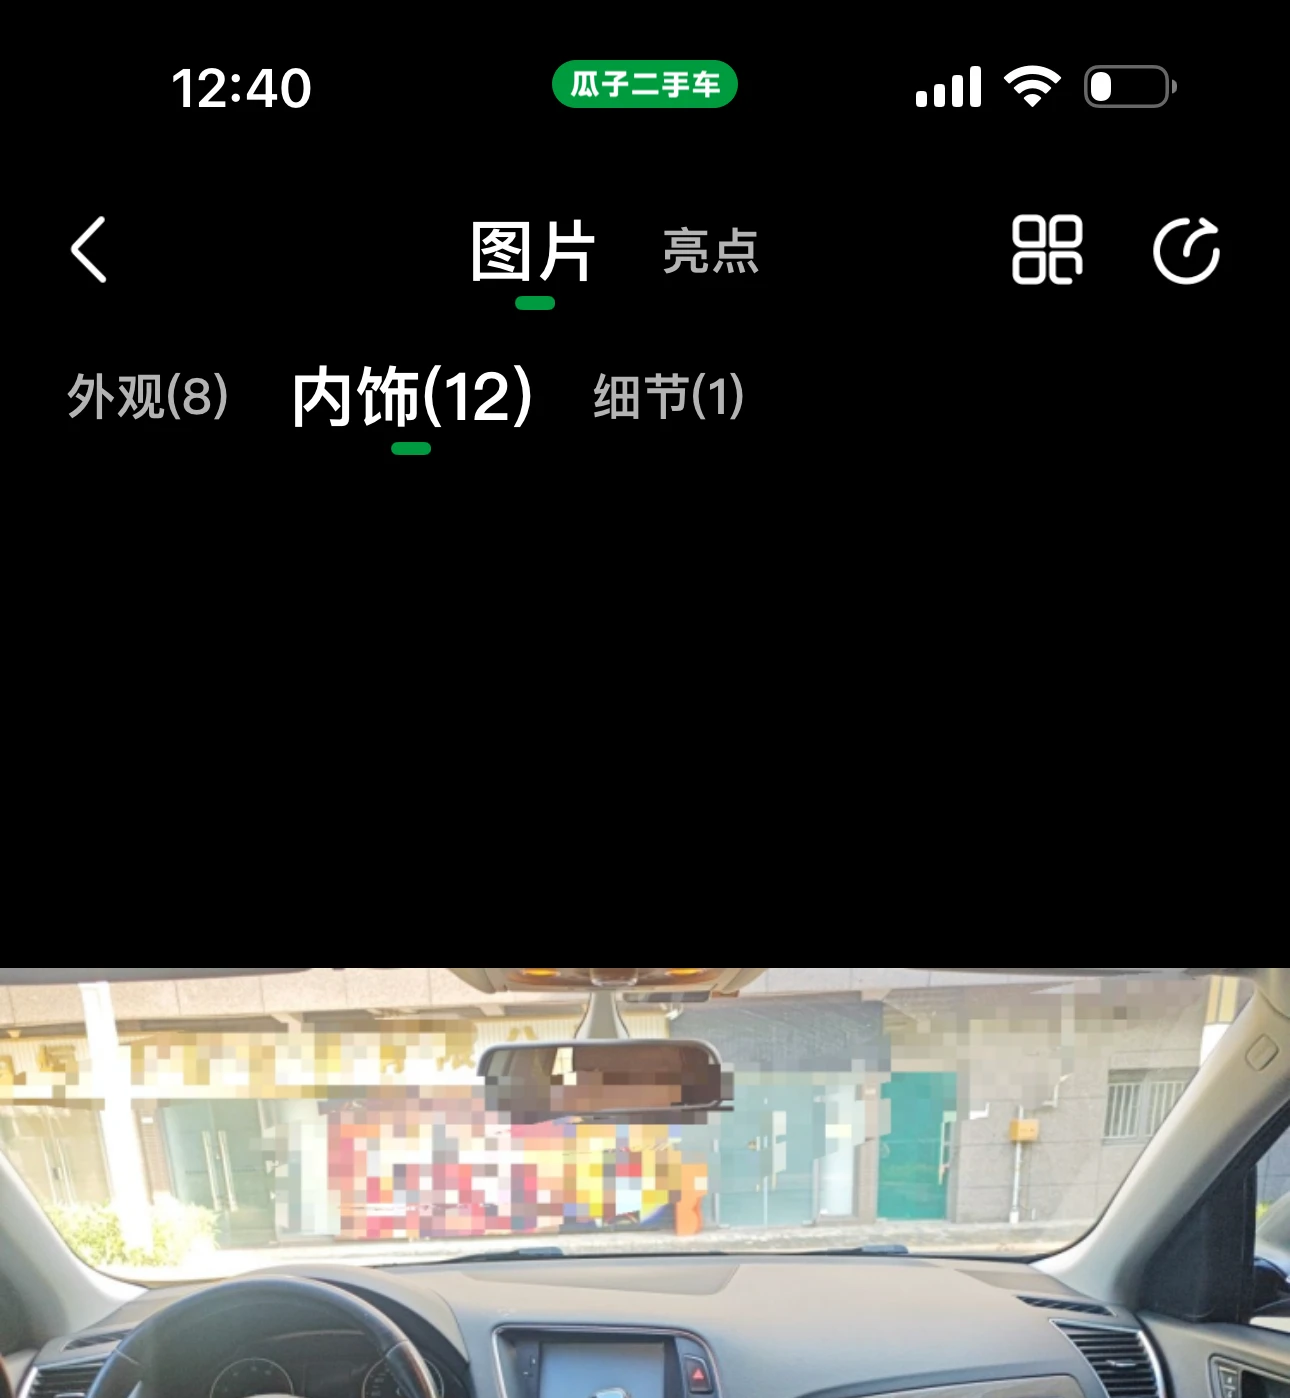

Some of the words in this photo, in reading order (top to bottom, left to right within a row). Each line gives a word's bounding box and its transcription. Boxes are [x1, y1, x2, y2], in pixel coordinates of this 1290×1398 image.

[172, 67, 312, 109] 12:40
[570, 69, 721, 99] 瓜子二手车
[472, 218, 595, 282] 图片
[663, 226, 759, 274] 亮点
[67, 372, 228, 421] 外观(8)
[294, 364, 531, 428] 内饰(12)
[593, 372, 744, 420] 细节(1)
